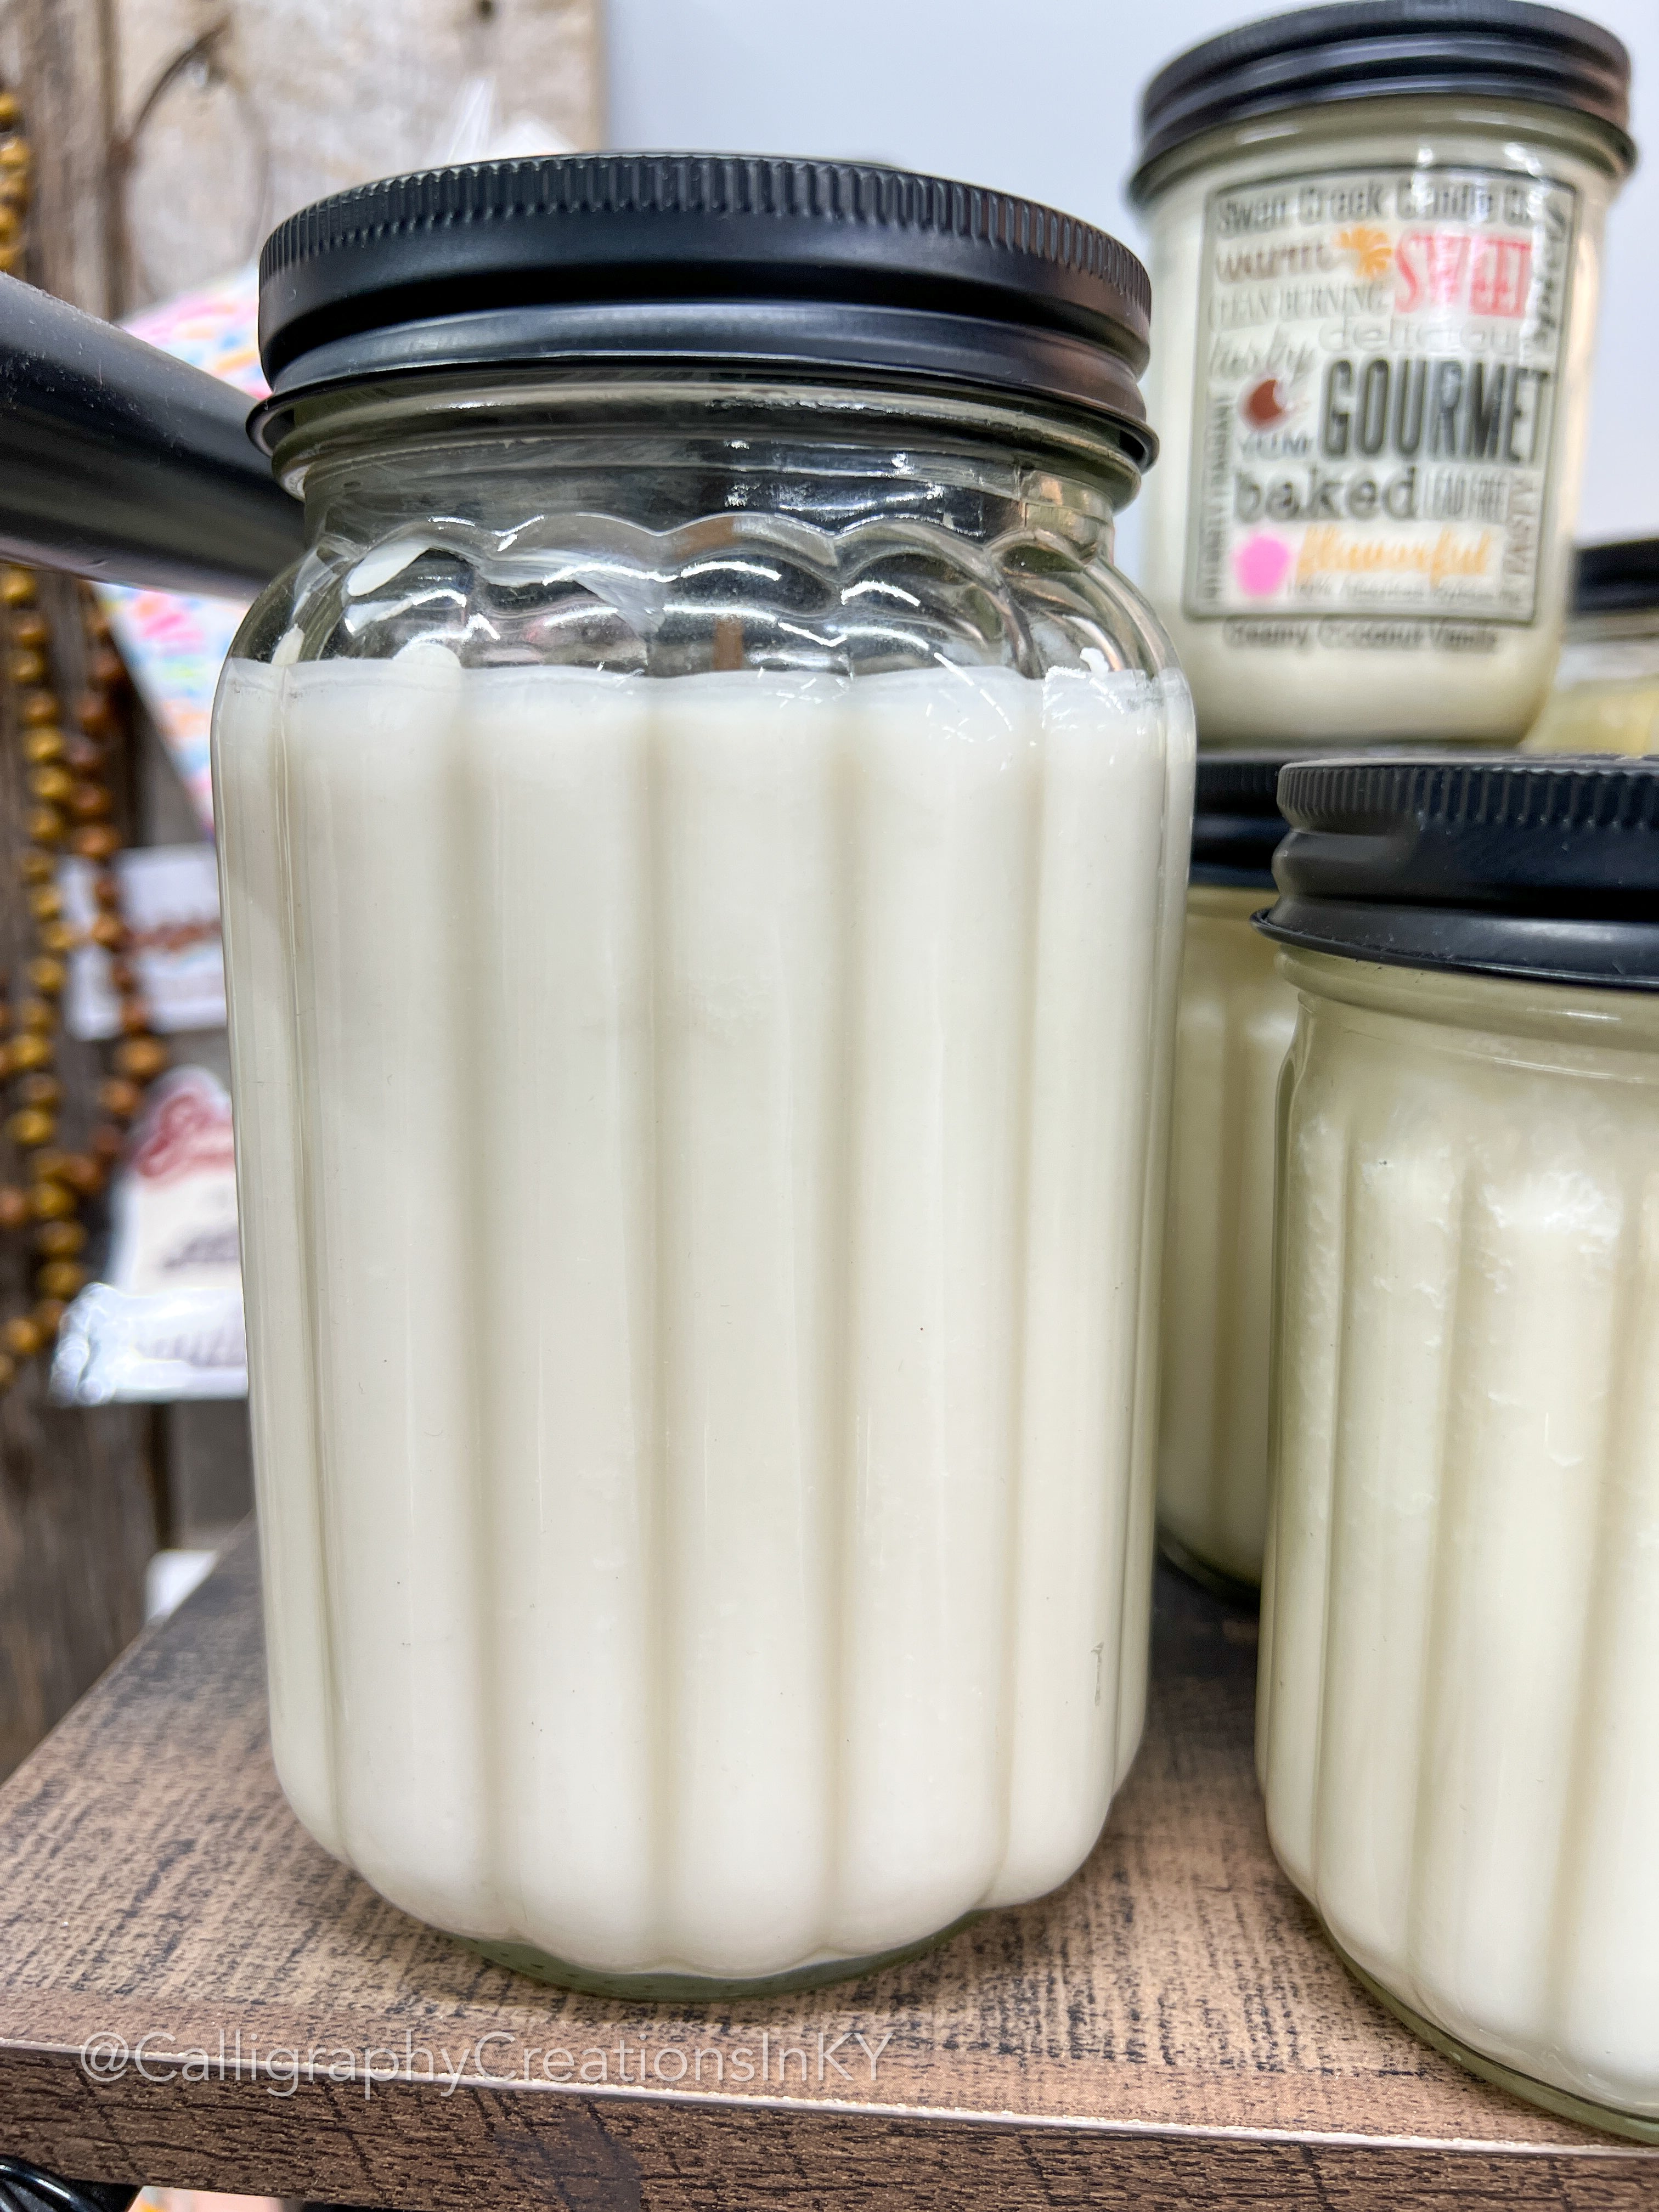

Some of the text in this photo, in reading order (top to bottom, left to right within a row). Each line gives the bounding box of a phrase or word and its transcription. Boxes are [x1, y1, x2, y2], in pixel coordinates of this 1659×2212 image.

[1295, 182, 1384, 227] Creek
[1396, 177, 1496, 223] Cndle
[1395, 228, 1532, 319] SWEET
[1319, 354, 1551, 466] GOURMET
[1233, 461, 1420, 526] baked
